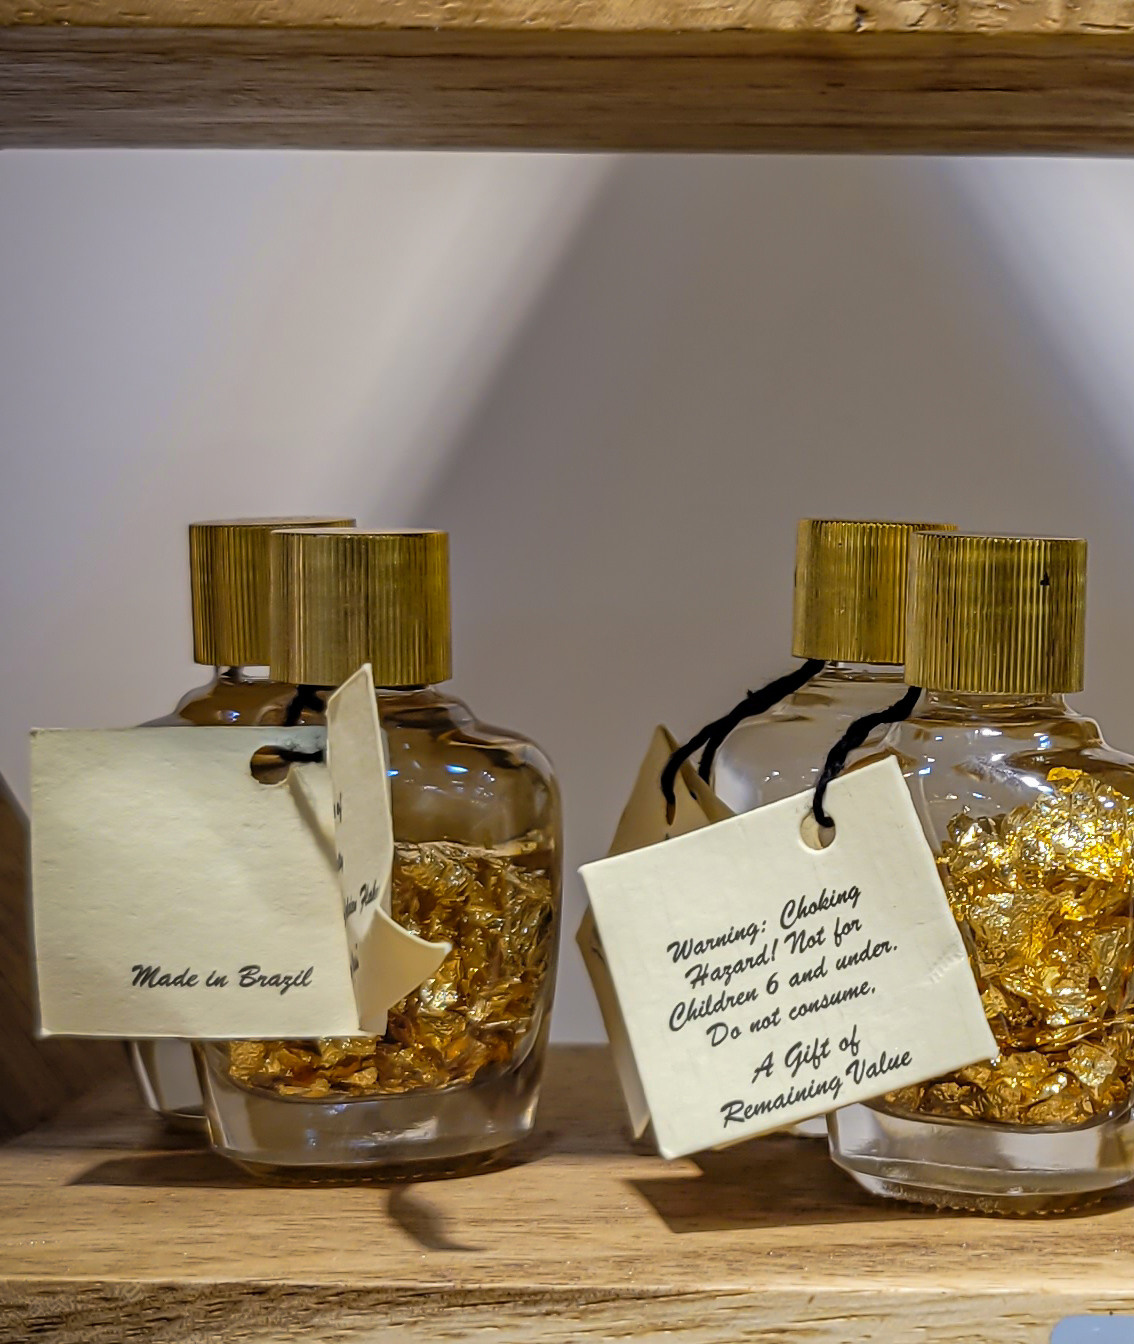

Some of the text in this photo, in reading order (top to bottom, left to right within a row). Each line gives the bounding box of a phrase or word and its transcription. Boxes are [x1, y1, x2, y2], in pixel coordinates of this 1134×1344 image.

[667, 885, 860, 963] Warning: Choking
[685, 916, 862, 989] Hazard! Not for
[131, 964, 315, 995] Made in Brazil
[669, 939, 898, 1032] Children 6 and under.
[706, 982, 876, 1047] Do not consume.
[720, 1050, 912, 1128] Remaining Value
[752, 1023, 860, 1083] A Gift of
